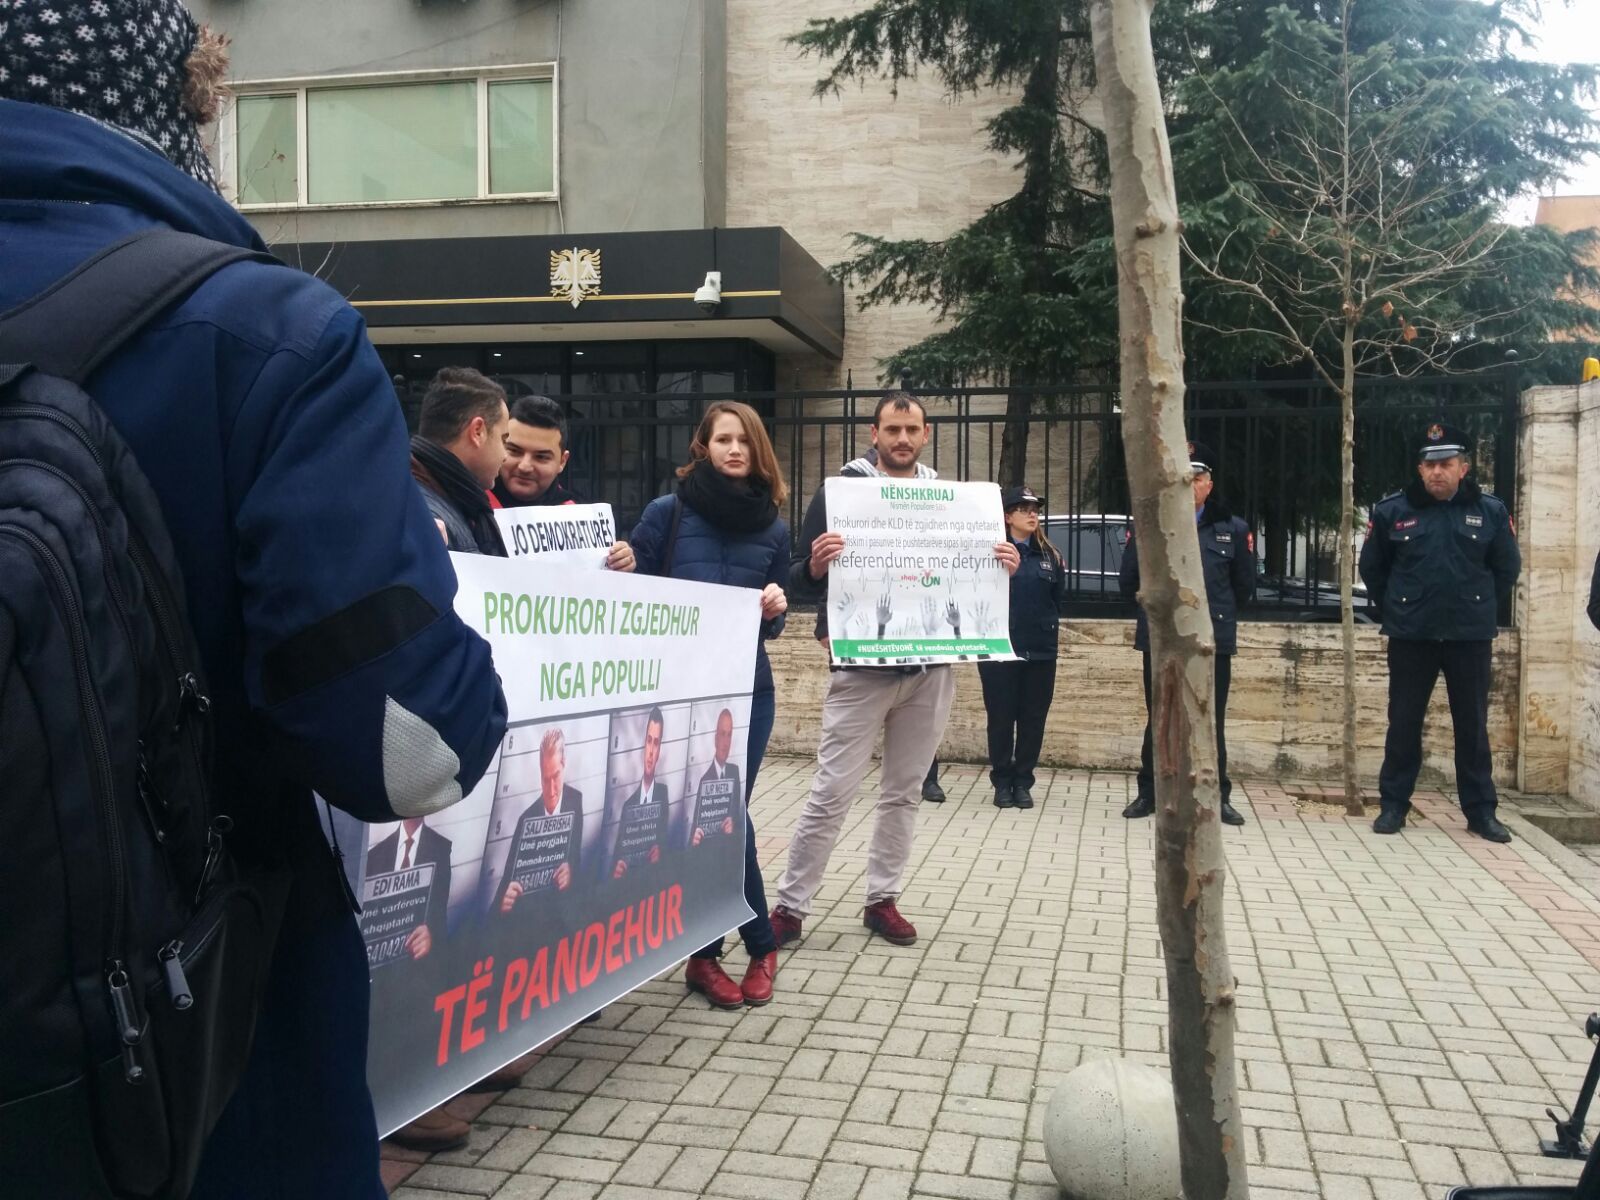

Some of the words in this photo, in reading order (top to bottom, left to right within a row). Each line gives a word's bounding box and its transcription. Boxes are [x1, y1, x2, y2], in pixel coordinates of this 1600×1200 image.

[881, 484, 954, 501] NËNSHKRUAJ
[511, 523, 528, 555] JO
[527, 512, 614, 553] DEMOKRATURËS
[833, 516, 869, 529] Prokurori
[871, 516, 886, 529] dhe
[888, 517, 903, 530] KLD
[905, 518, 913, 530] të
[950, 521, 964, 533] nga
[967, 519, 999, 533] qytetarët
[895, 537, 902, 547] të
[943, 537, 959, 550] sipas
[832, 550, 924, 569] Referendume
[928, 556, 948, 569] me
[484, 592, 607, 634] PROKUROR
[610, 600, 616, 635] I
[619, 601, 700, 636] ZGJEDHUR
[540, 660, 586, 701] NGA
[591, 658, 662, 697] POPULLI
[524, 820, 541, 836] SALI
[541, 815, 572, 833] BERISHA
[520, 840, 535, 851] Unë
[516, 852, 565, 868] Demokracinë
[372, 876, 392, 896] EDI
[392, 870, 420, 892] RAMA
[381, 896, 426, 914] varfërova
[363, 913, 414, 936] shqiptarët
[433, 956, 494, 1067] TË
[498, 883, 684, 1033] PANDEHUR
